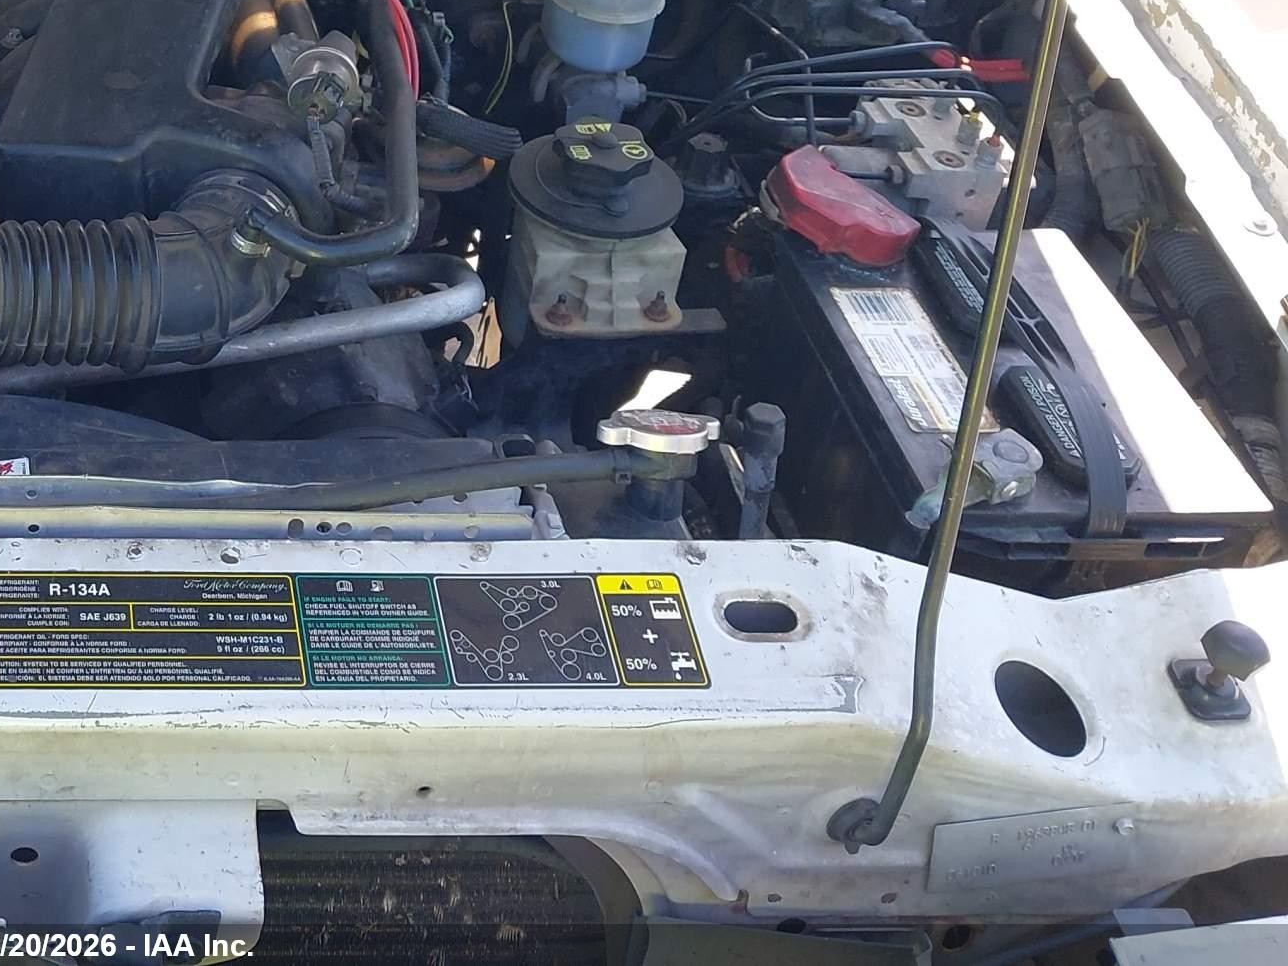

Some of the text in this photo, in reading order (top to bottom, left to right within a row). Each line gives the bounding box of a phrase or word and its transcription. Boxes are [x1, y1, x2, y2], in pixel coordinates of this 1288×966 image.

[541, 580, 560, 588] 3.0L
[49, 583, 110, 596] R-134A
[612, 605, 642, 616] 50%
[80, 613, 126, 621] SAE J639
[208, 613, 213, 621] 2
[216, 613, 225, 621] lb
[228, 613, 232, 621] 1
[234, 613, 244, 621] oz
[251, 613, 271, 621] (0.94
[273, 613, 288, 621] kg)
[216, 636, 284, 644] WSH-M1C231-B
[217, 645, 222, 653] 9
[224, 645, 231, 653] fl
[233, 645, 242, 653] oz
[251, 645, 269, 653] (266
[271, 645, 285, 653] cc)
[626, 659, 657, 670] 50%
[508, 673, 529, 681] 2.3L
